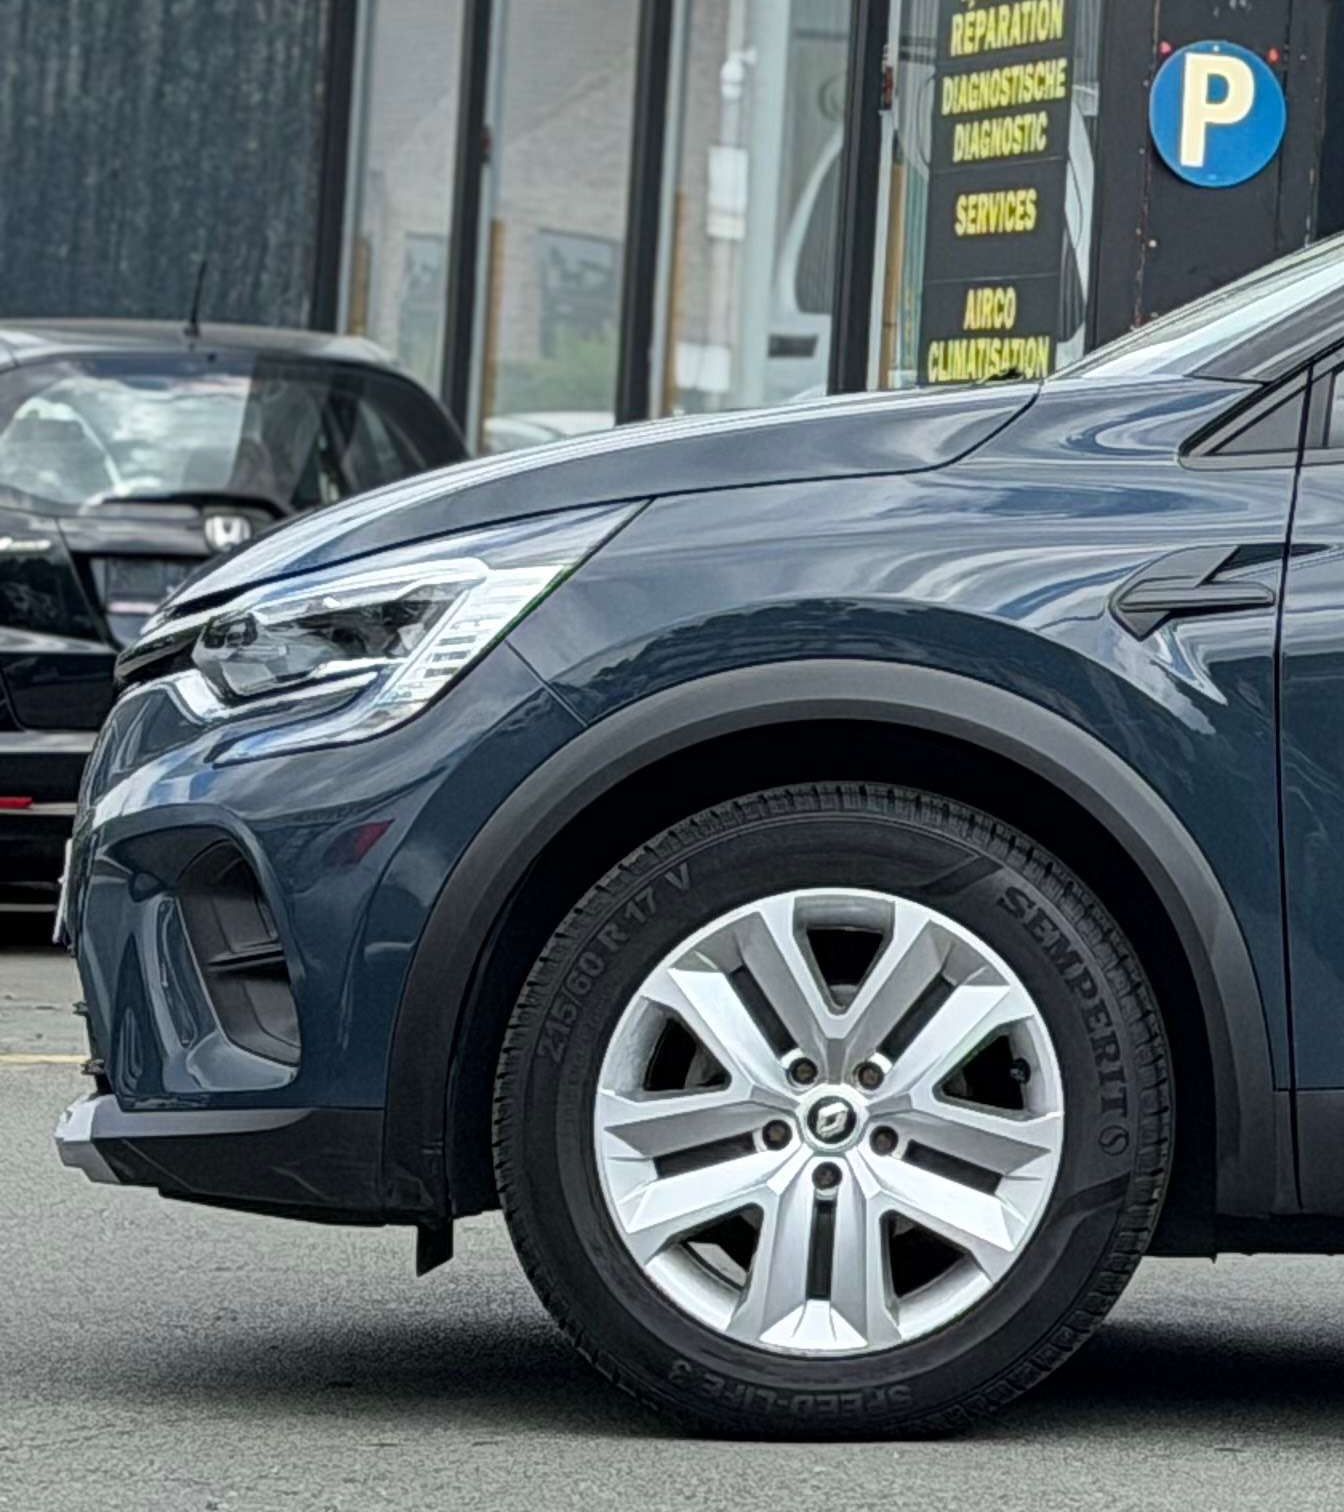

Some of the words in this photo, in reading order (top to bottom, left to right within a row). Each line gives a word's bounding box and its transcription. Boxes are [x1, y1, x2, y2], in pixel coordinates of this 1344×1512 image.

[941, 57, 1067, 116] DIAGNOSTISCHE
[1180, 51, 1255, 168] P
[952, 110, 1048, 163] DIAGNOSTIC
[954, 188, 1038, 238] SERVICES
[963, 285, 1018, 331] AIRCO
[927, 335, 1050, 384] CLIMATISATION
[599, 923, 627, 952] R
[625, 885, 657, 924] 17
[664, 862, 691, 890] V
[998, 885, 1129, 1118] SEMPERIT
